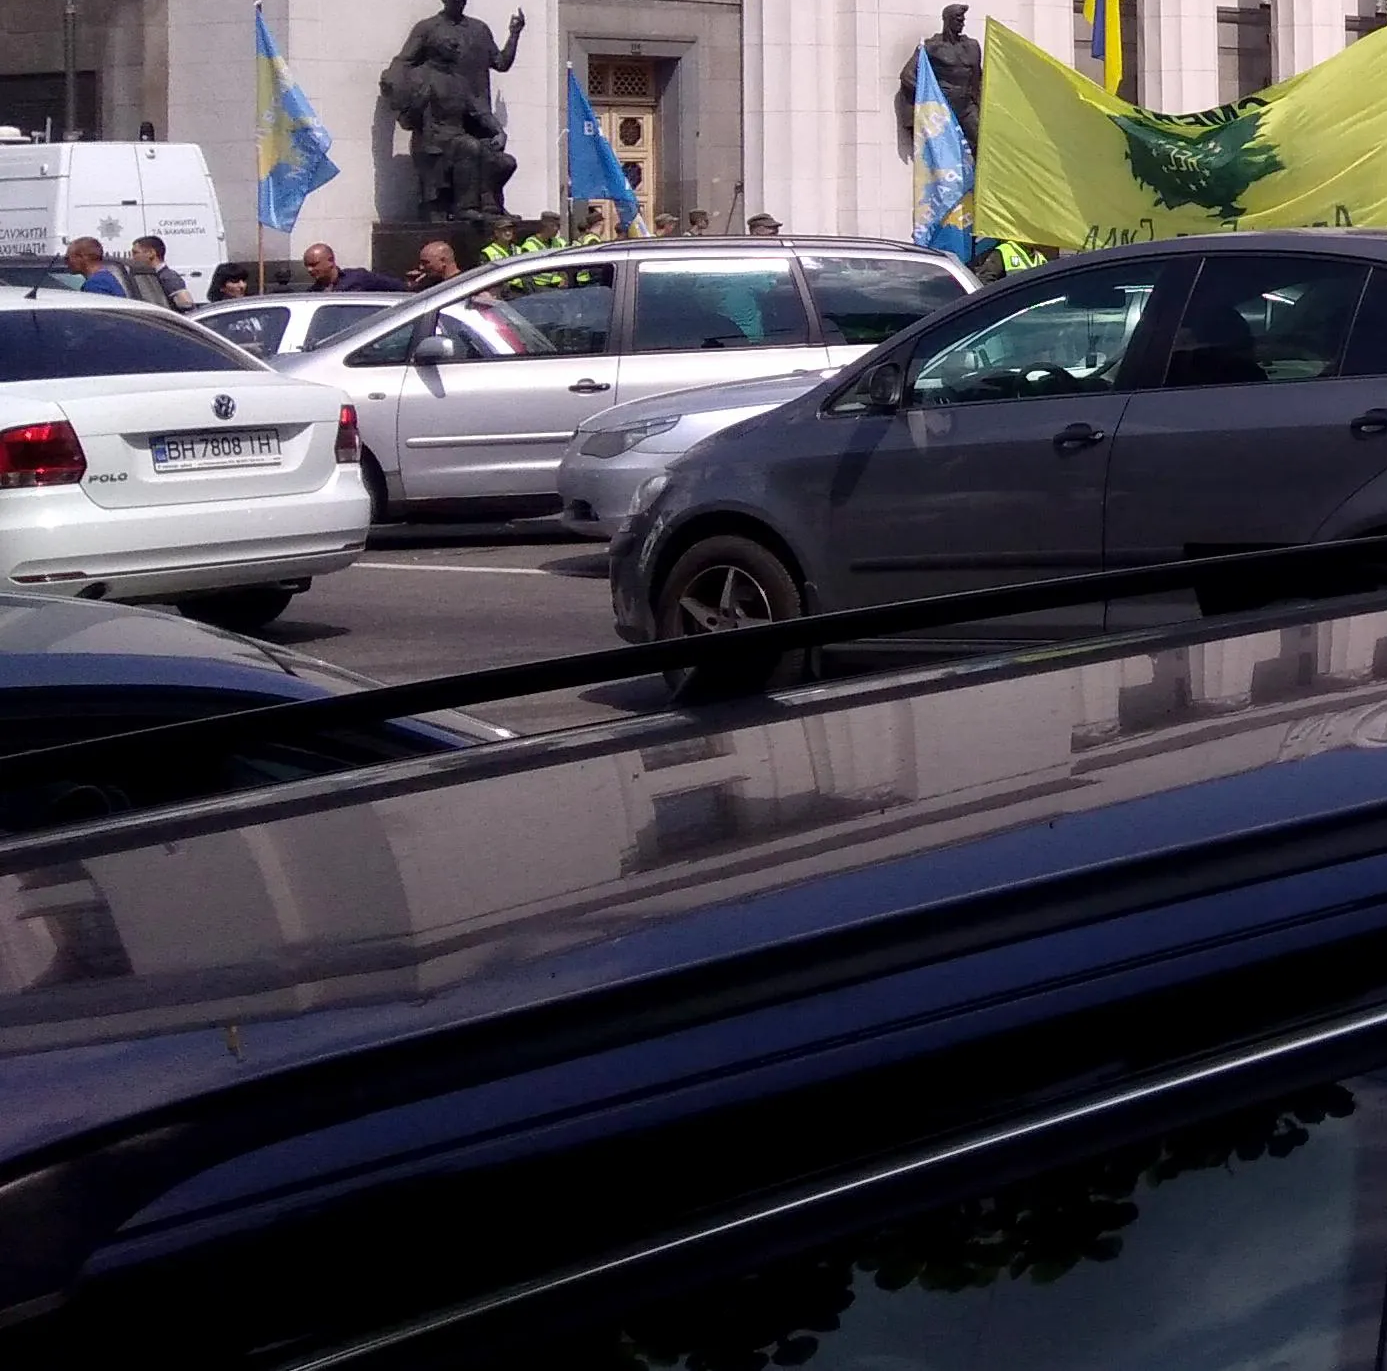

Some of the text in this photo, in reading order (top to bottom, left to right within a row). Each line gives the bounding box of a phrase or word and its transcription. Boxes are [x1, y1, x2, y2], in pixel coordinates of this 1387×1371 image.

[167, 438, 196, 461] BH
[201, 436, 243, 458] 7808
[88, 472, 128, 484] POLO
